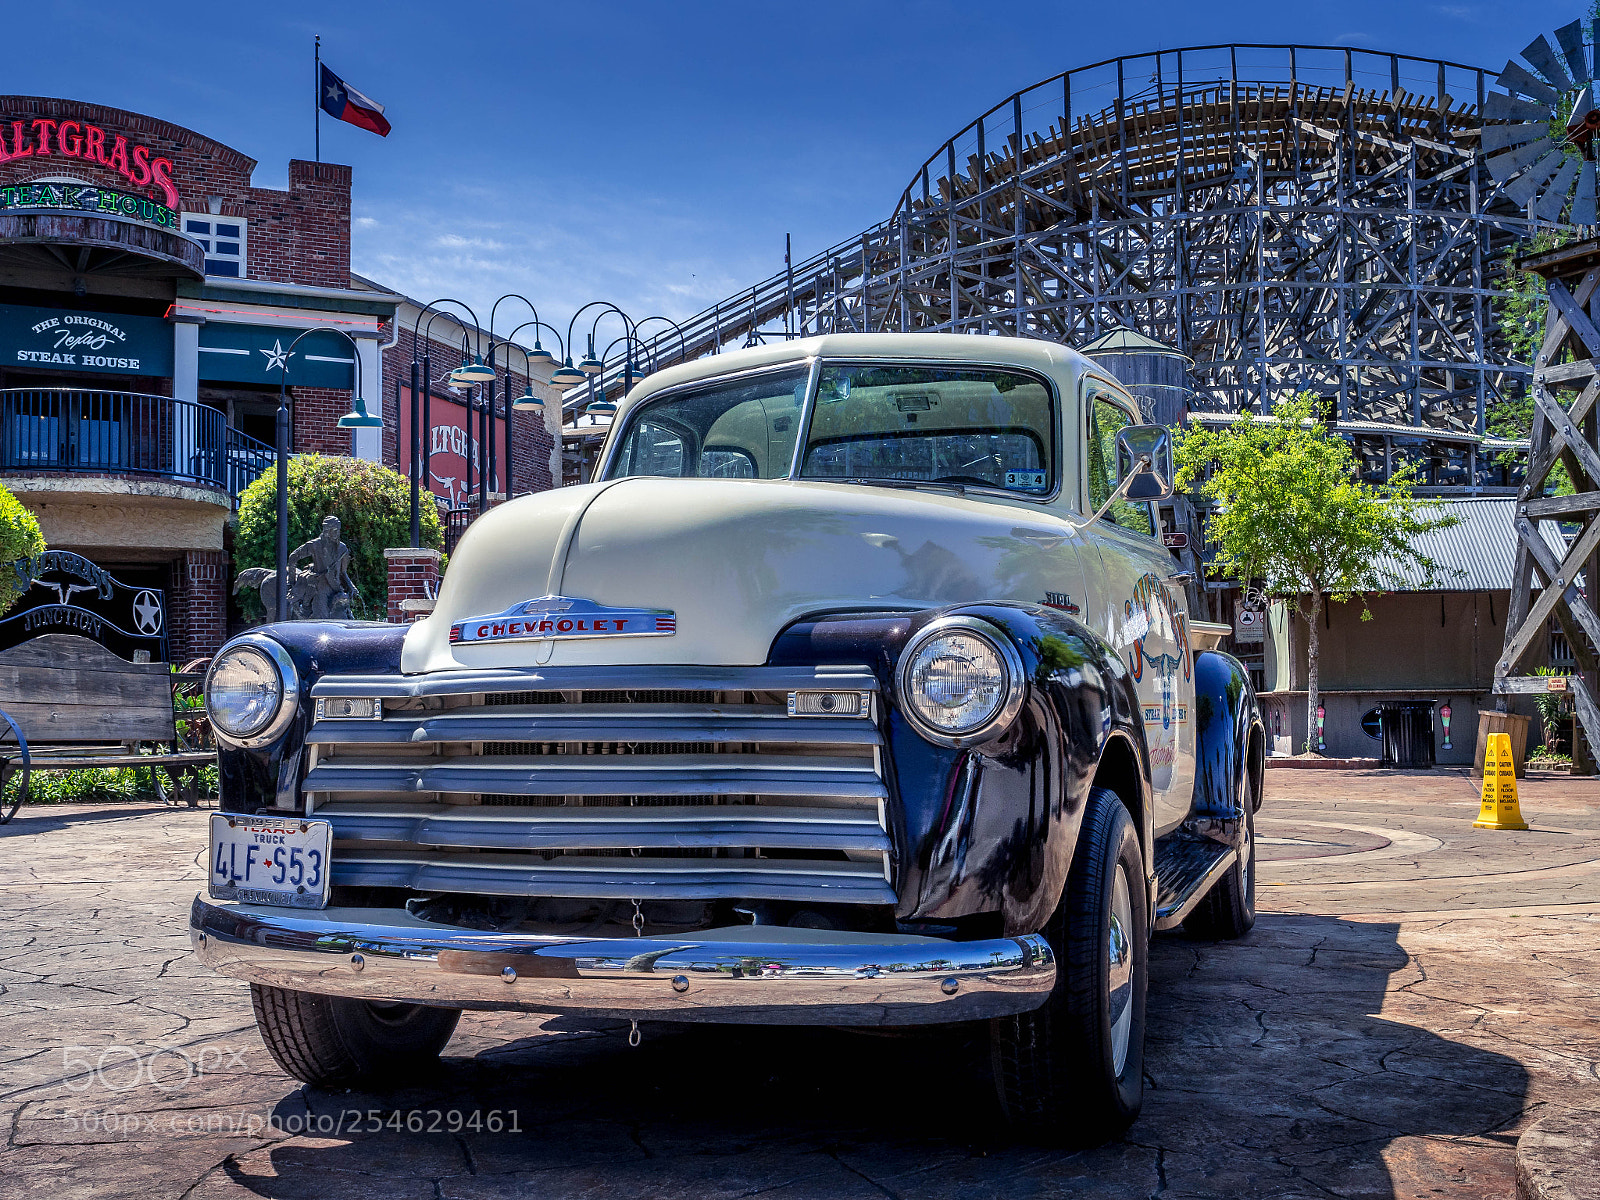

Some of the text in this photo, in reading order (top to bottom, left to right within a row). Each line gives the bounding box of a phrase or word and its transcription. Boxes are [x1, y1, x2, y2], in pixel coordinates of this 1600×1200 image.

[98, 190, 177, 229] HOUSE
[31, 315, 127, 342] THE ORIGINAL
[53, 329, 115, 351] Texas
[17, 350, 140, 370] STEAK HOUSE
[1007, 473, 1016, 484] 3
[1034, 474, 1043, 485] 4
[25, 607, 101, 637] JUNCTION
[477, 619, 629, 638] CHEVROLET
[254, 833, 286, 845] TRUCK
[215, 841, 260, 882] 4LF
